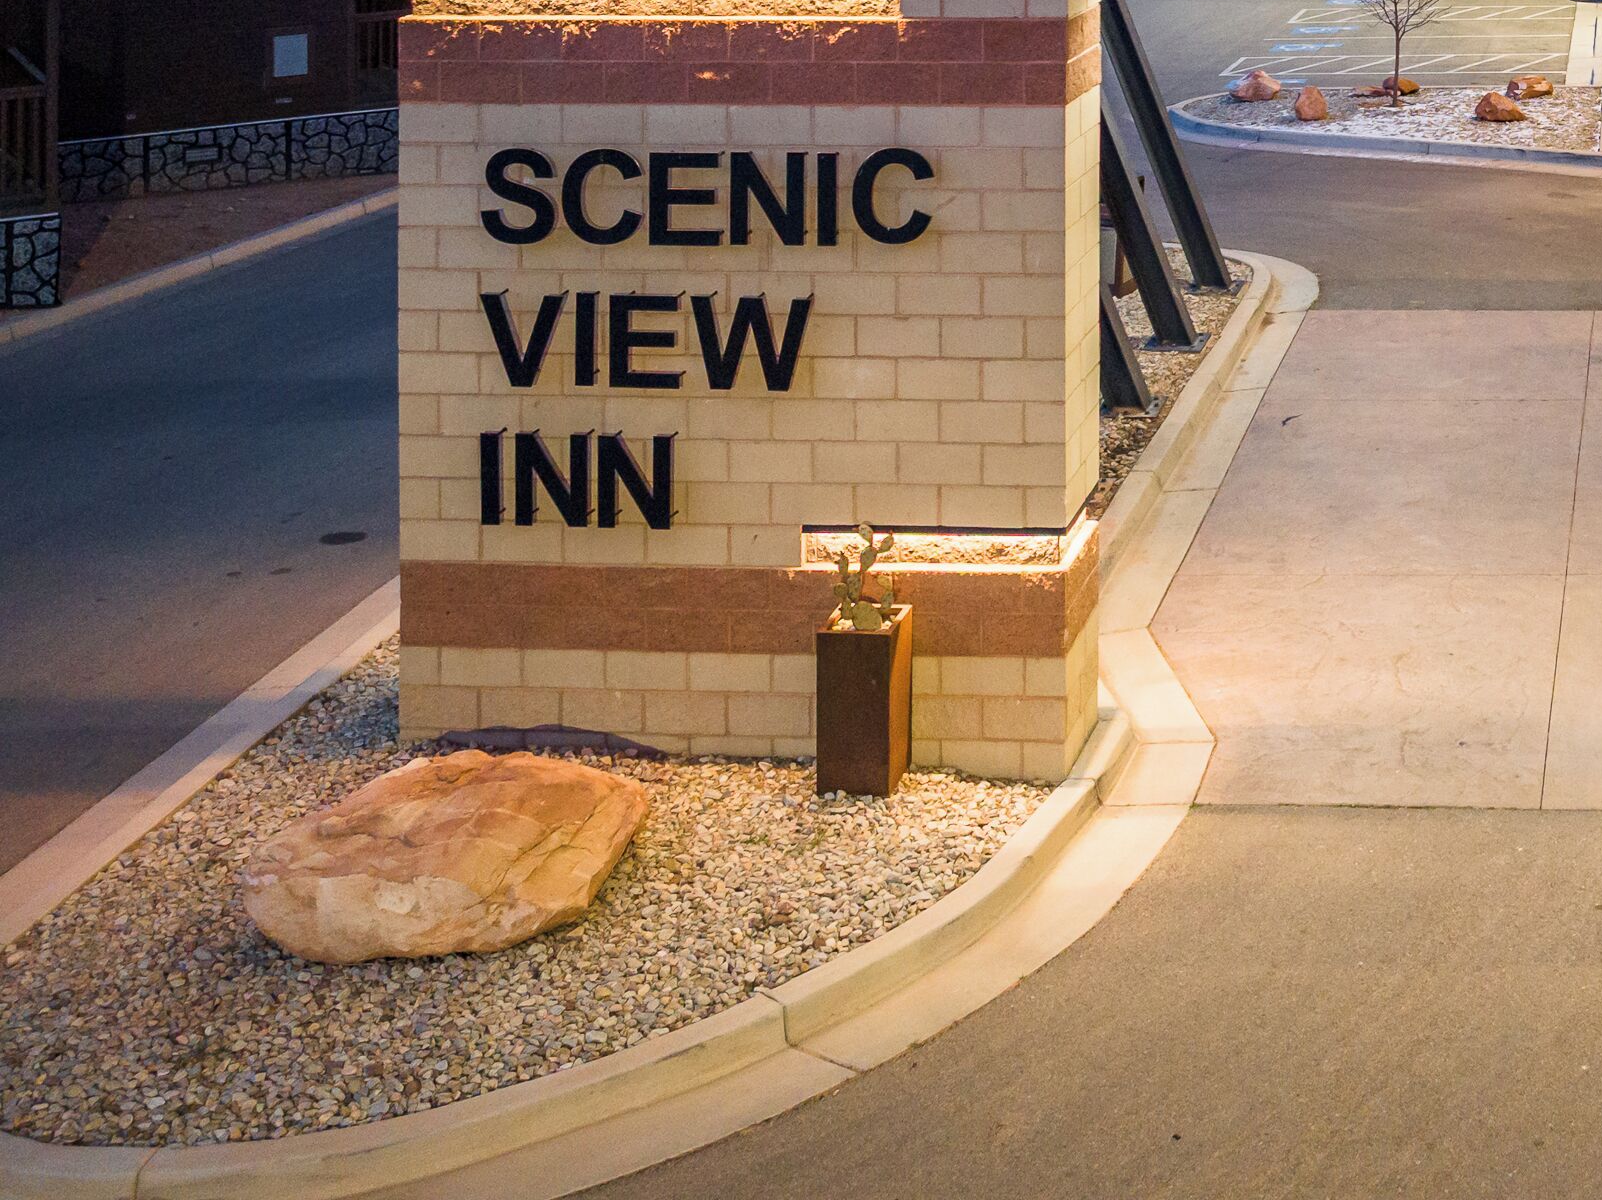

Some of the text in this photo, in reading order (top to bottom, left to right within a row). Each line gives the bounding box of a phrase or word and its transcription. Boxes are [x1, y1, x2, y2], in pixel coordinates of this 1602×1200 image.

[480, 146, 936, 247] SCENIC
[480, 289, 815, 392] VIEW
[480, 427, 680, 530] INN
